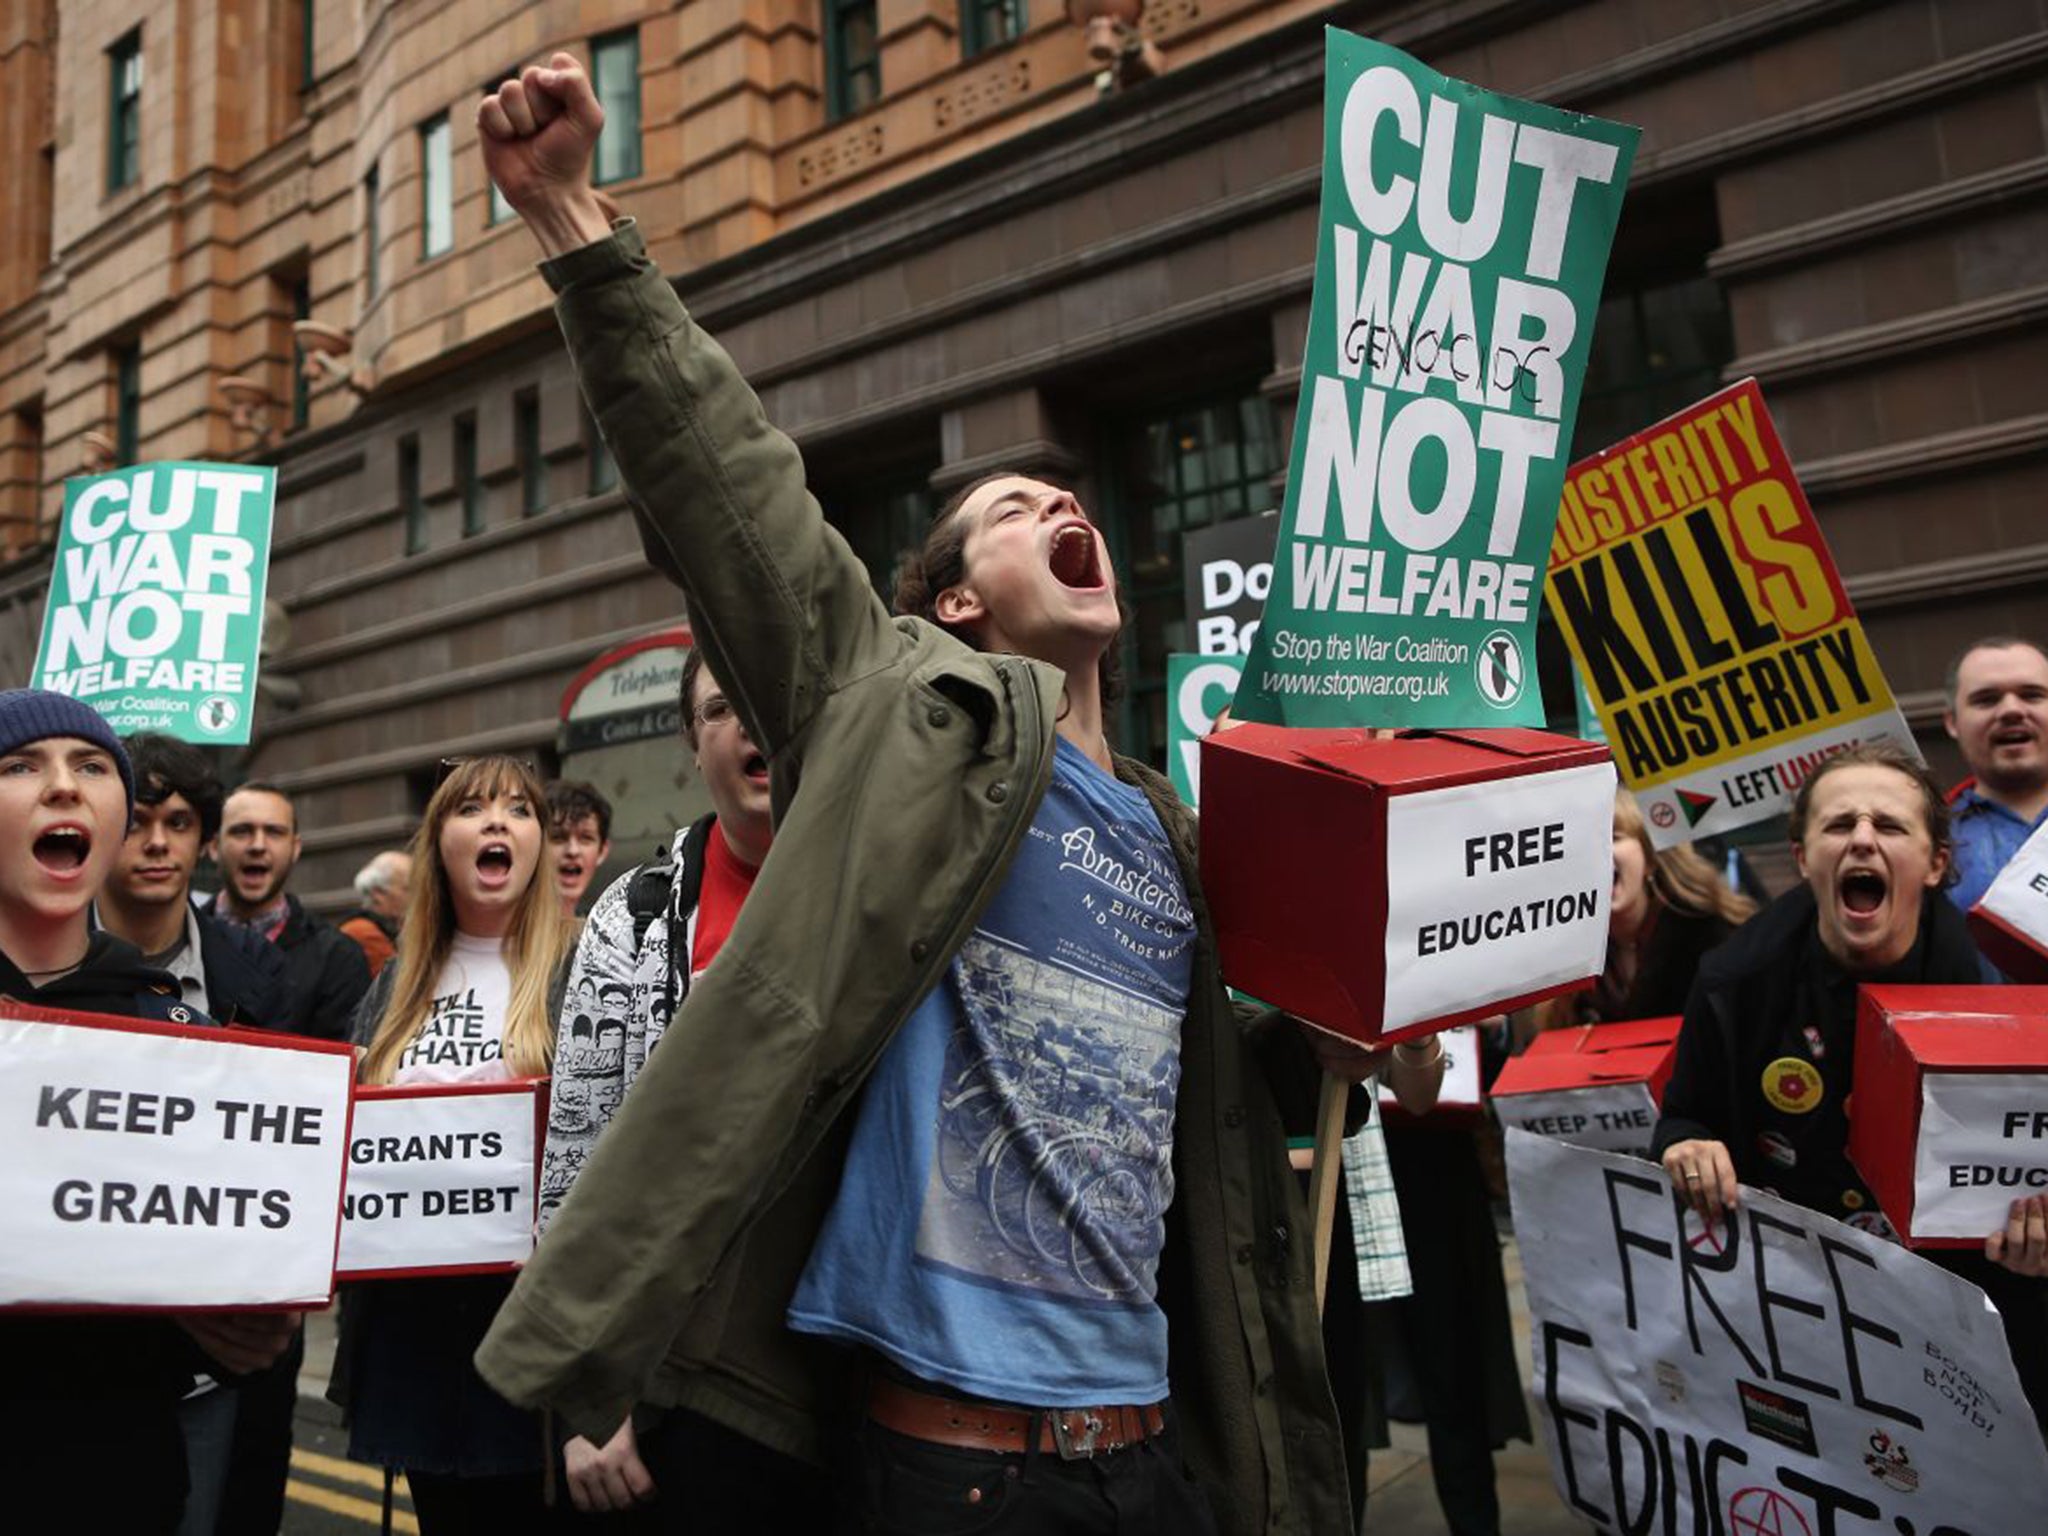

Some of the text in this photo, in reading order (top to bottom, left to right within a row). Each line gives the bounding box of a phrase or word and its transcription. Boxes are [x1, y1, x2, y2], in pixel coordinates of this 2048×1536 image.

[1341, 65, 1619, 281] CUT
[1334, 224, 1576, 419] WAR
[1295, 375, 1560, 556] NOT
[70, 469, 264, 545] CUT
[65, 531, 254, 606] WAR
[1292, 541, 1535, 622] WELFARE
[1552, 479, 1838, 706] KILLS
[44, 588, 250, 673] NOT
[1271, 630, 1469, 666] Stop the War Coalition
[43, 658, 245, 698] WELFARE
[121, 695, 189, 712] Coalition
[1262, 670, 1450, 702] www.stopwar.org.uk
[1614, 628, 1872, 778] AUSTERITY
[1465, 822, 1564, 877] FREE
[1110, 899, 1153, 929] BIKE
[1114, 927, 1152, 958] TRADE
[1417, 889, 1597, 957] EDUCATION
[431, 988, 484, 1018] TILL
[35, 1085, 323, 1146] KEEP THE
[1522, 1109, 1651, 1136] KEEP THE
[351, 1131, 503, 1164] GRANTS
[52, 1180, 292, 1229] GRANTS
[422, 1186, 520, 1216] DEBT
[1603, 1167, 1925, 1431] FREE
